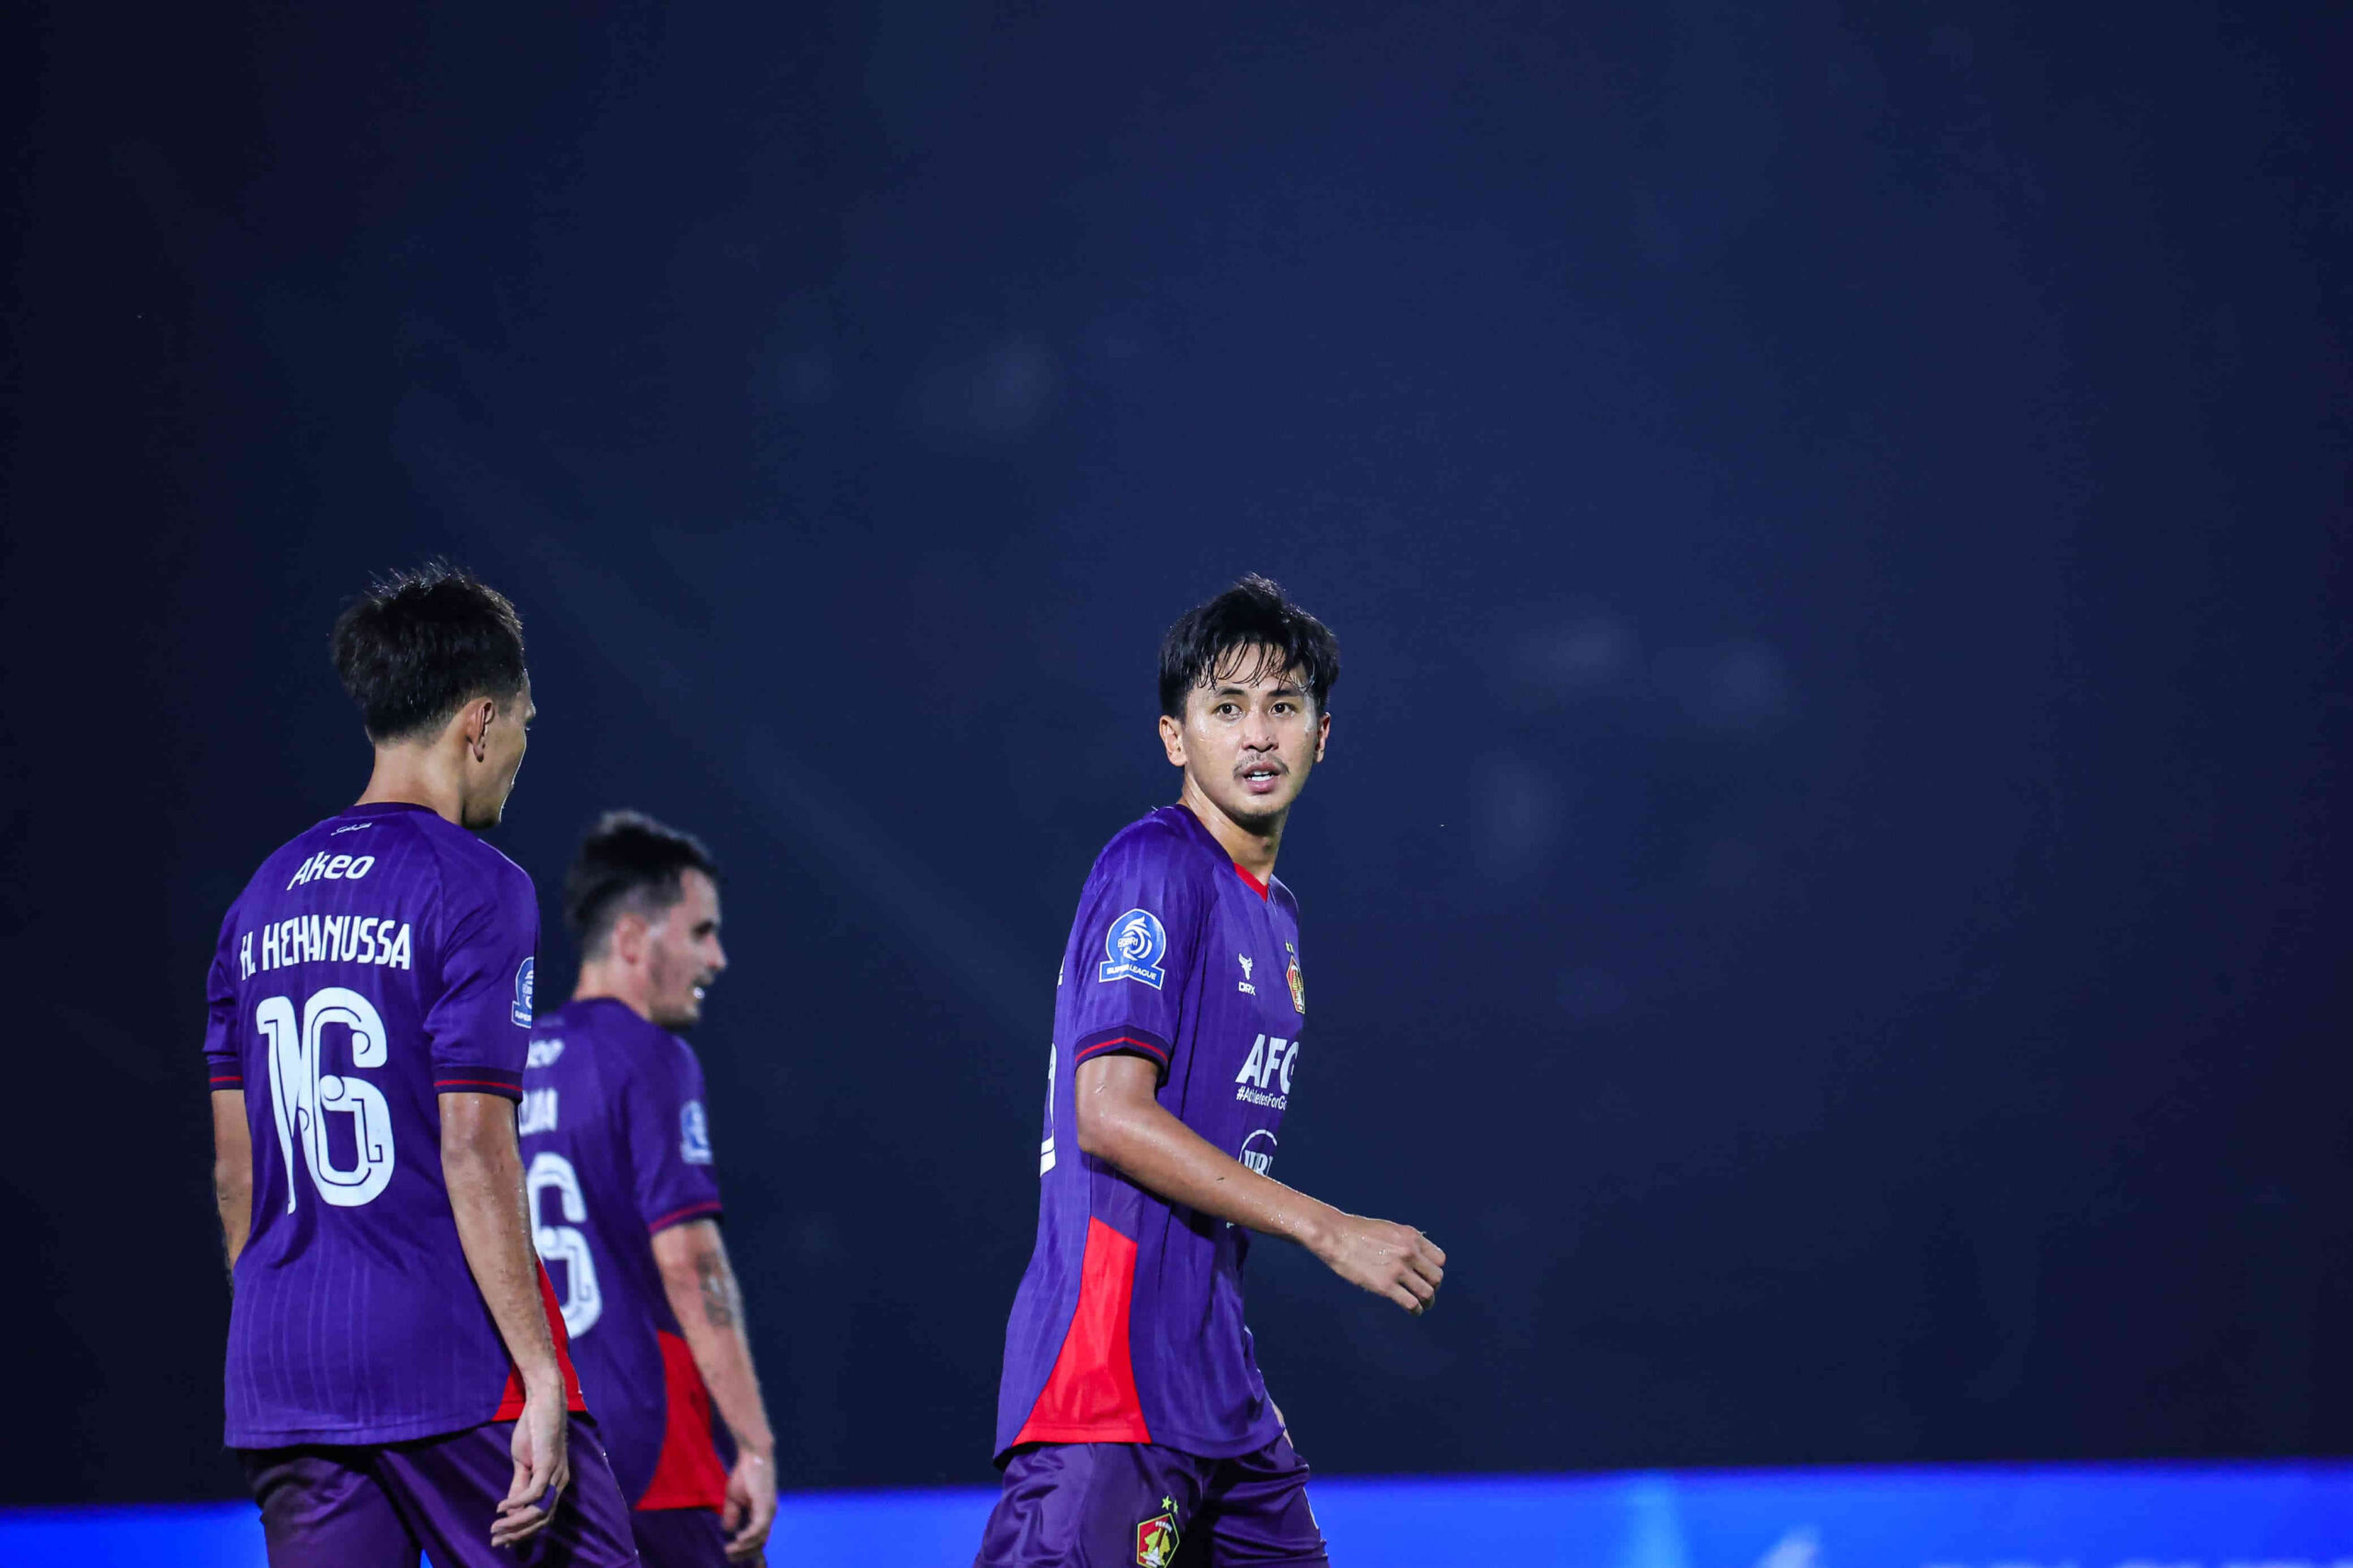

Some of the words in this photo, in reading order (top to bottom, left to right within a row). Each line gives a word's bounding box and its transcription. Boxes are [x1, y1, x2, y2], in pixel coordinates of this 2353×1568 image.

[287, 850, 375, 890] Akeo
[262, 915, 410, 971] HEHANUSSA
[1130, 964, 1157, 981] LEAGUE
[1238, 981, 1256, 996] DRX
[256, 987, 395, 1215] 16
